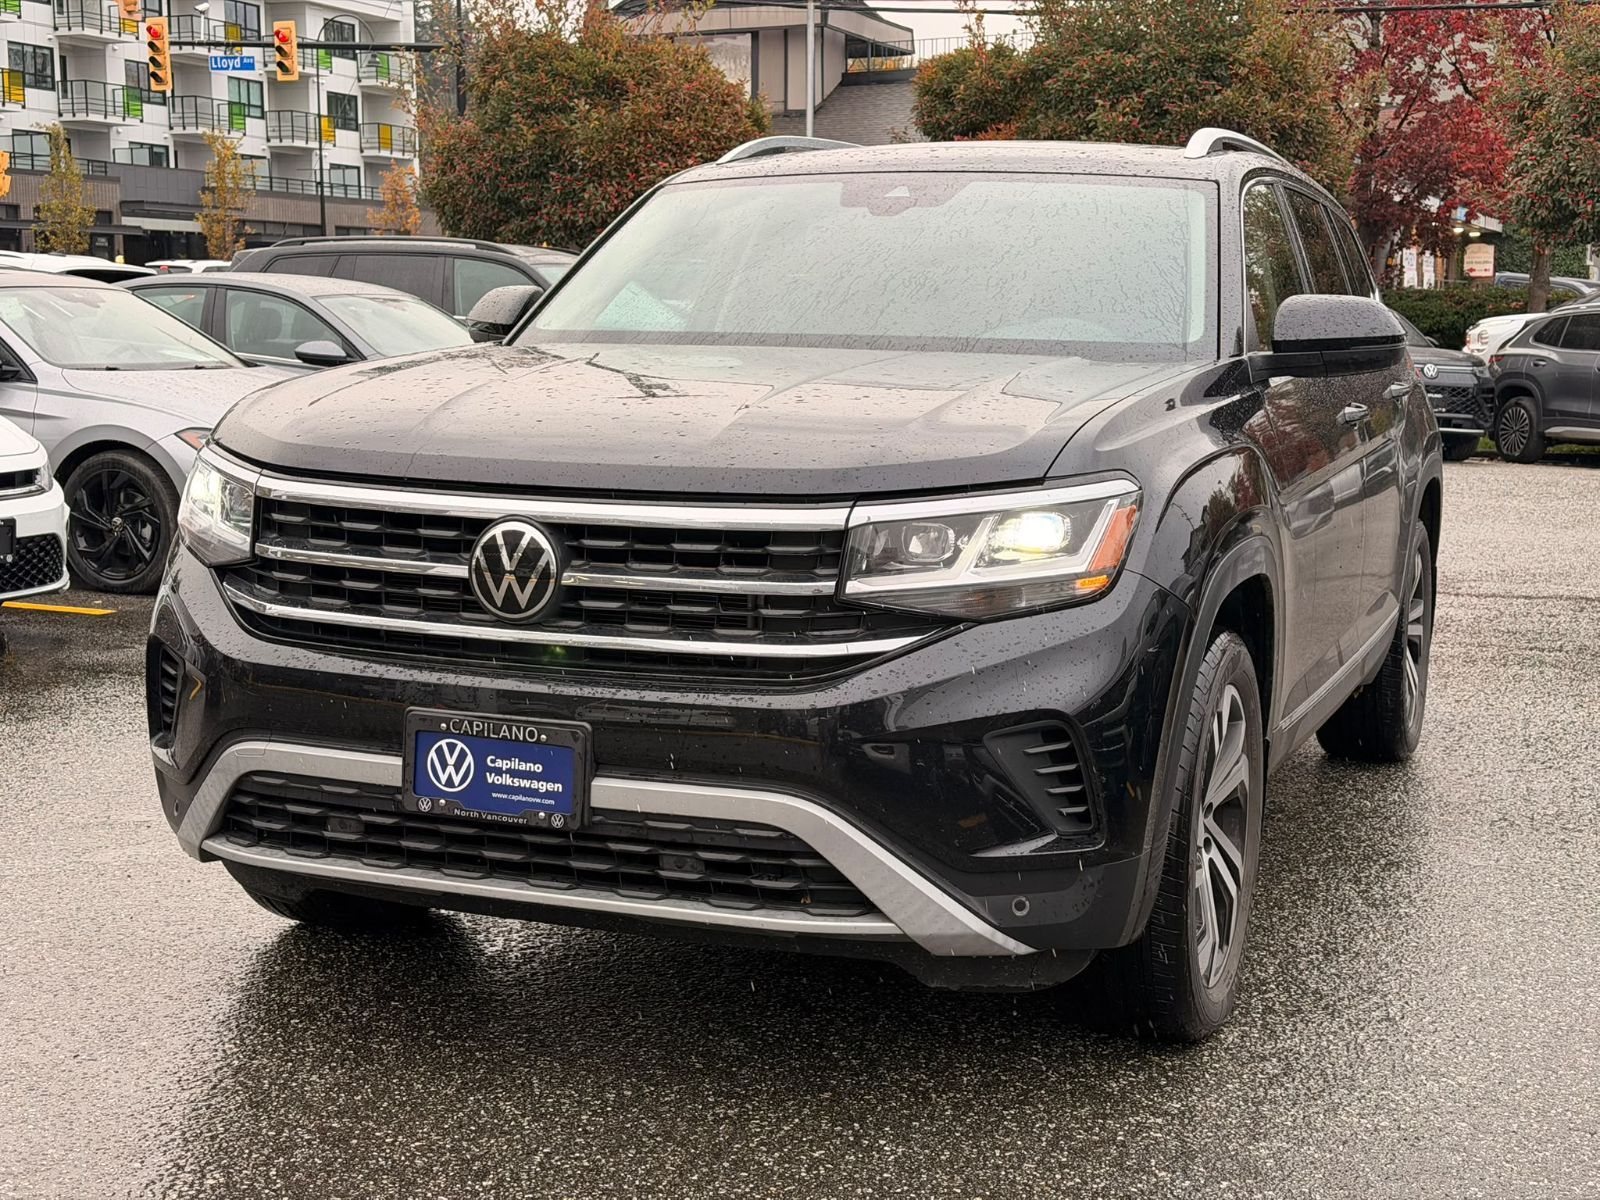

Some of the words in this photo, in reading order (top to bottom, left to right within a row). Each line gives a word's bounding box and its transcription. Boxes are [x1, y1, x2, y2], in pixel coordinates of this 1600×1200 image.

[212, 56, 241, 70] Lloyd
[449, 718, 538, 742] CAPILANO
[427, 738, 474, 792] VW
[486, 755, 543, 773] Capilano
[485, 772, 562, 793] Volkswagen
[491, 791, 555, 805] www.capilanovw.com
[454, 808, 479, 819] North
[480, 811, 528, 825] Vancouver
